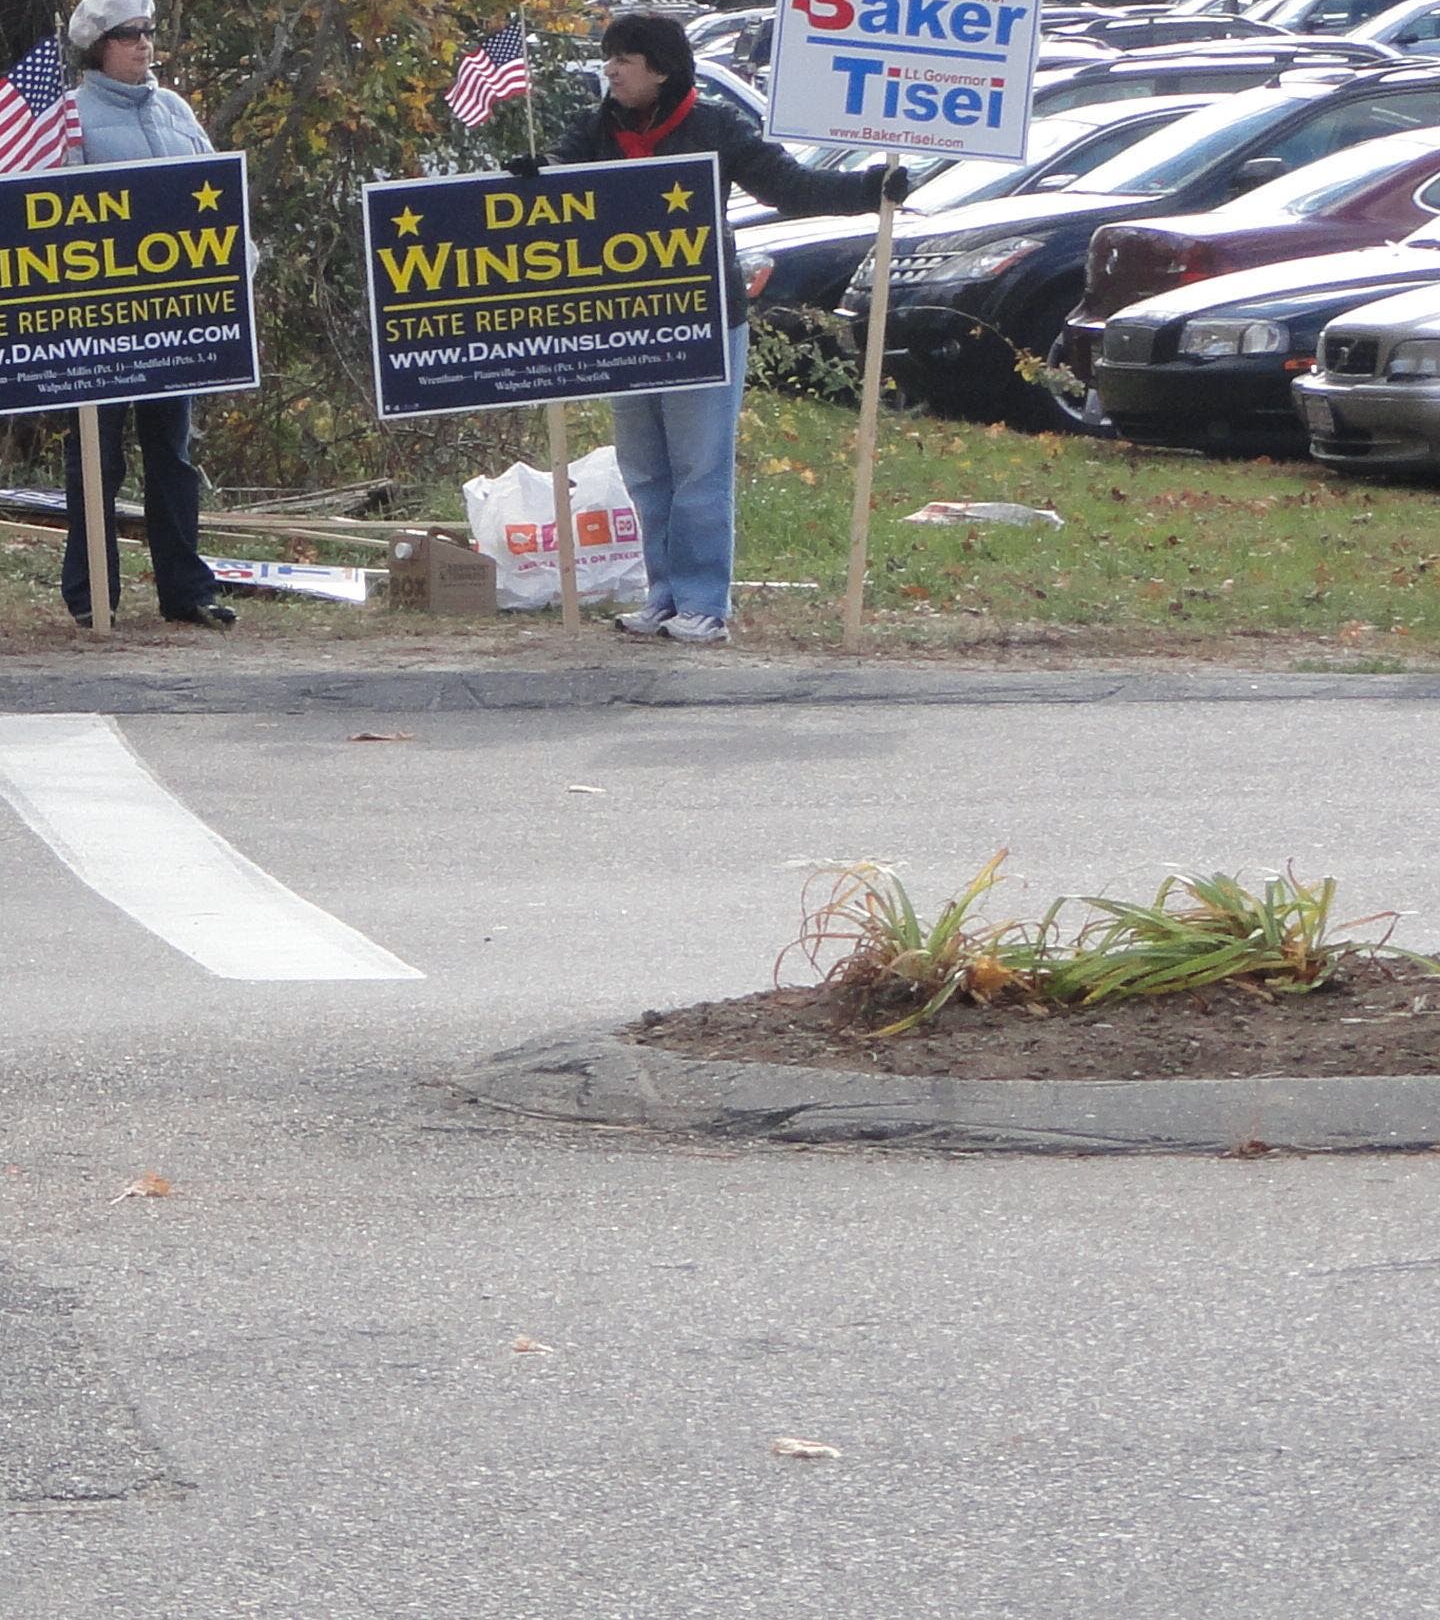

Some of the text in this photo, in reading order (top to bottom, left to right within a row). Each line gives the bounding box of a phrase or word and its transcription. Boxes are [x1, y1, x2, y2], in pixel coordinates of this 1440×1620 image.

[832, 55, 1006, 128] Tisei
[923, 70, 985, 87] Governor
[829, 127, 964, 149] www.BakerTisei.com
[25, 189, 132, 230] DAN
[484, 191, 597, 230] DAN
[377, 226, 711, 294] WINSLOW
[19, 289, 237, 335] REPRESENTATIVE
[385, 289, 708, 343] STATE REPRESENTATIVE
